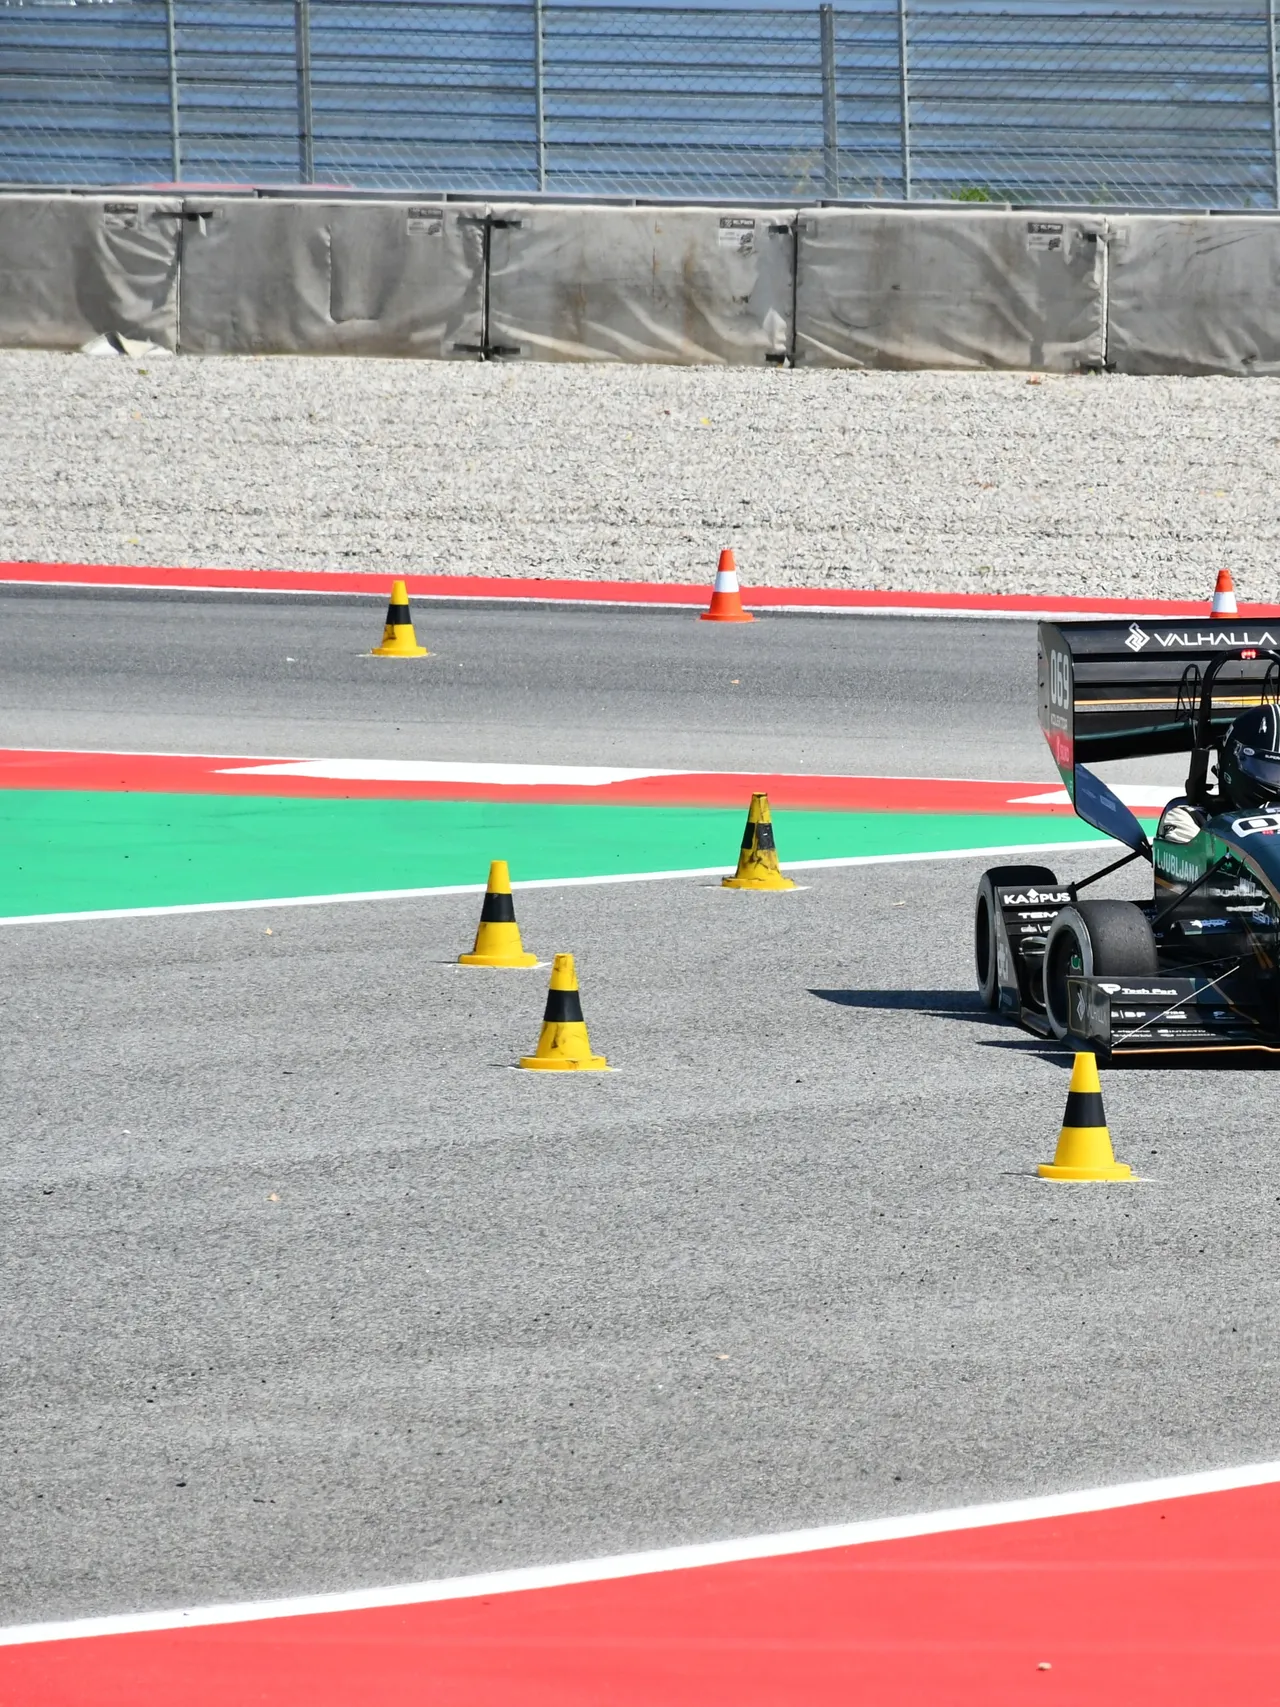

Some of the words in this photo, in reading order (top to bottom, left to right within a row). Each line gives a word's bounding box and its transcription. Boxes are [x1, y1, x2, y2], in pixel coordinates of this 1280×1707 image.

[1154, 631, 1278, 647] VALHALLA
[1050, 649, 1069, 710] 069
[1156, 849, 1200, 884] LJUBLJANA
